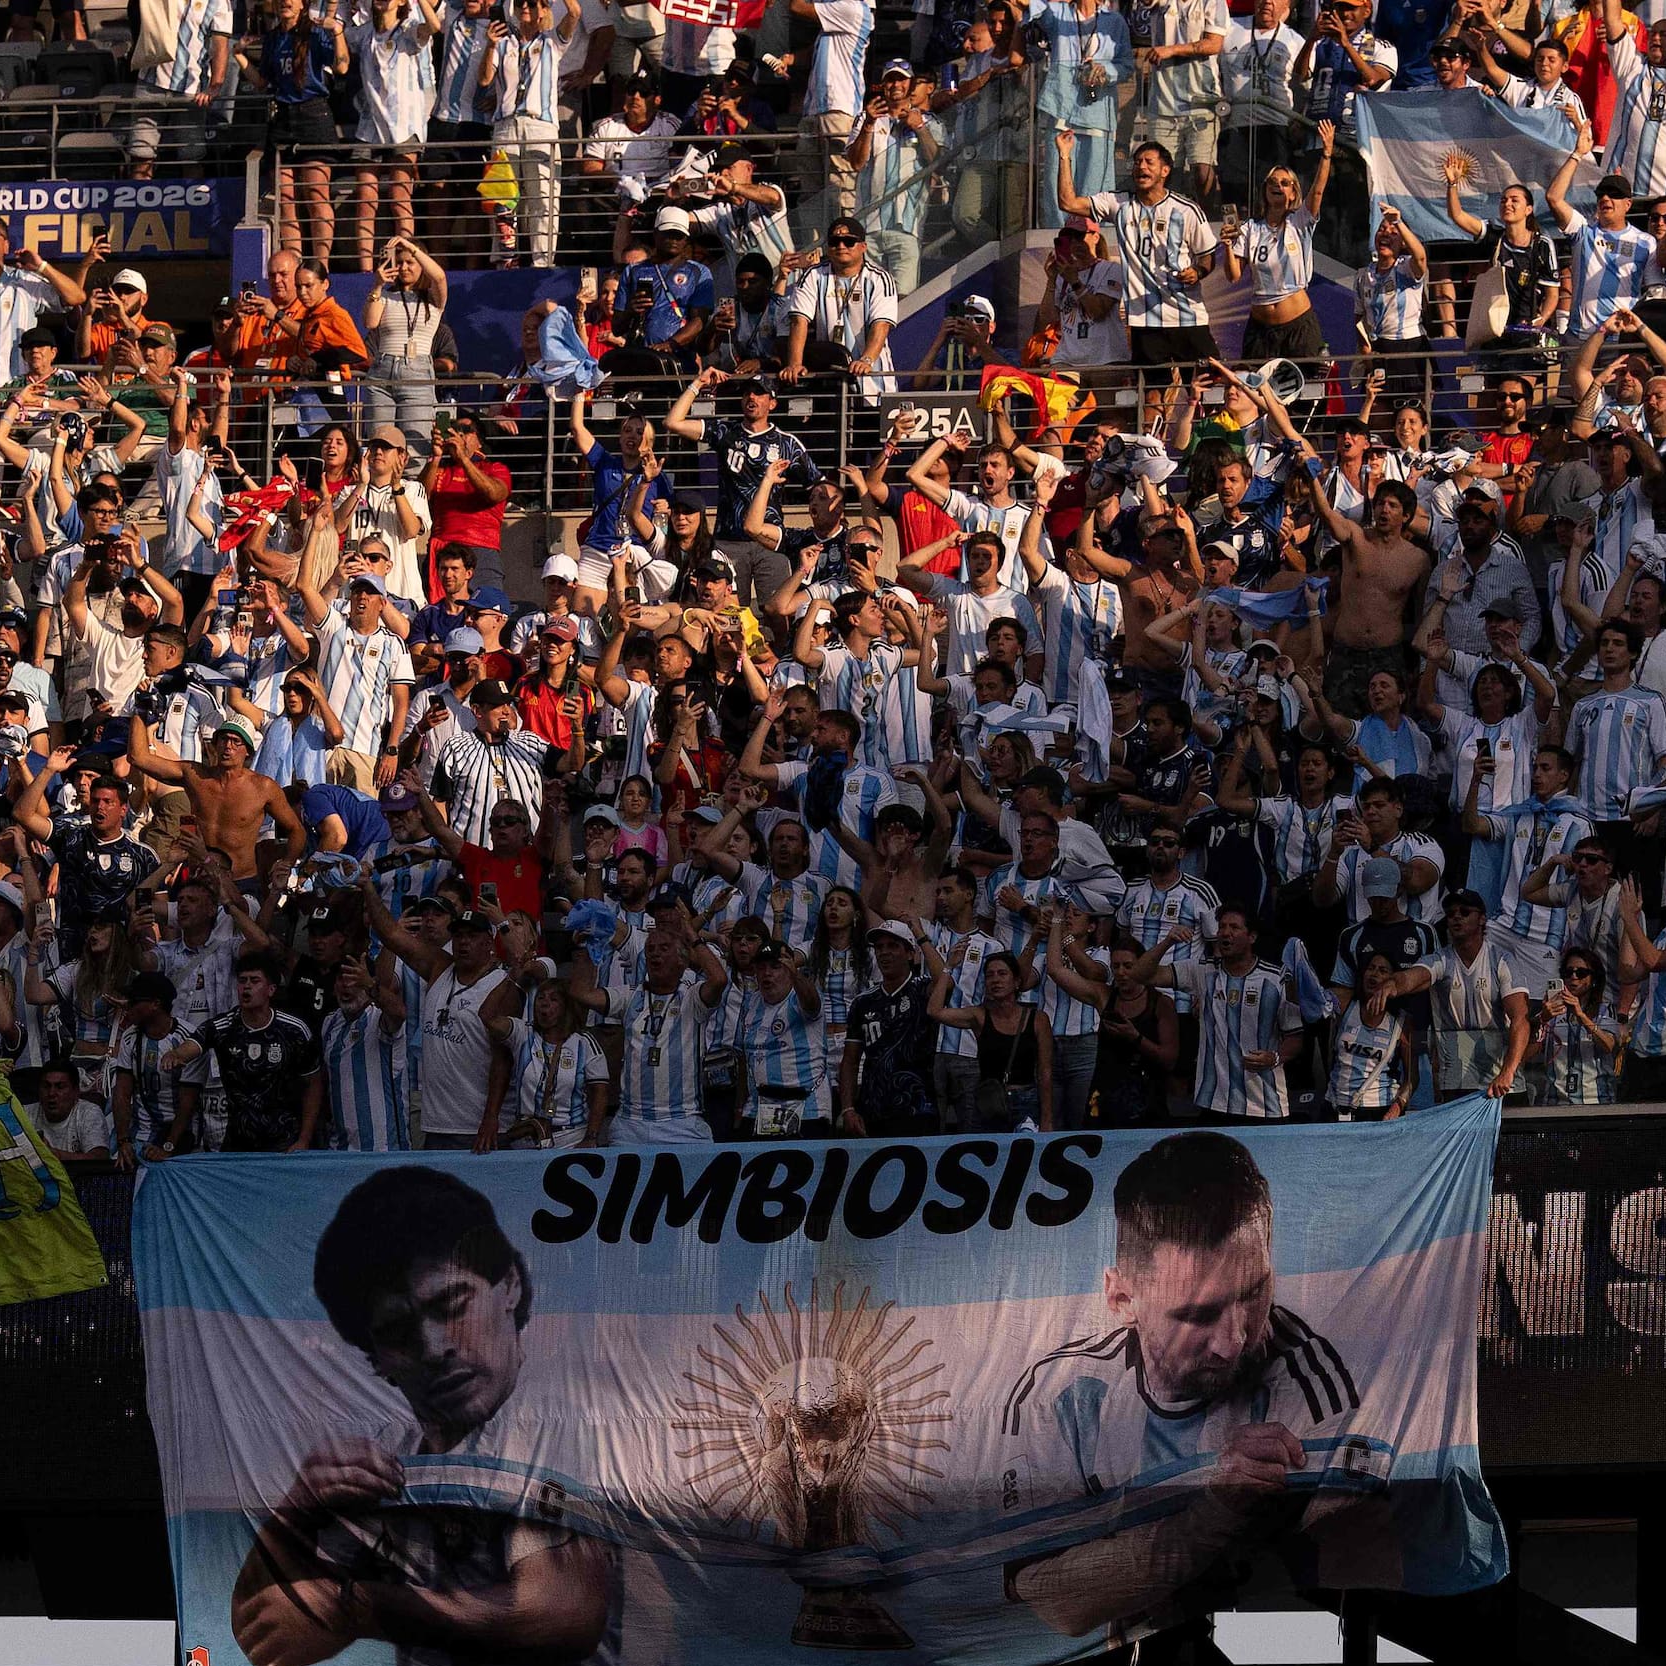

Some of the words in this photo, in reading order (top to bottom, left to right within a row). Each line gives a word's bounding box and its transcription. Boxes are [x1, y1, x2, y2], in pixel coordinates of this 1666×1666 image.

[52, 187, 109, 209] CUP
[114, 185, 211, 208] 2026
[23, 211, 209, 254] FINAL
[1252, 245, 1269, 264] 18
[727, 449, 745, 474] 10
[1581, 706, 1600, 728] 19
[1209, 826, 1226, 848] 19
[392, 873, 412, 894] 10
[313, 987, 324, 1011] 5
[642, 1015, 660, 1036] 10
[1342, 1039, 1384, 1062] VISA
[531, 1135, 1102, 1244] SIMBIOSIS
[1341, 1439, 1373, 1480] C
[540, 1479, 565, 1520] C
